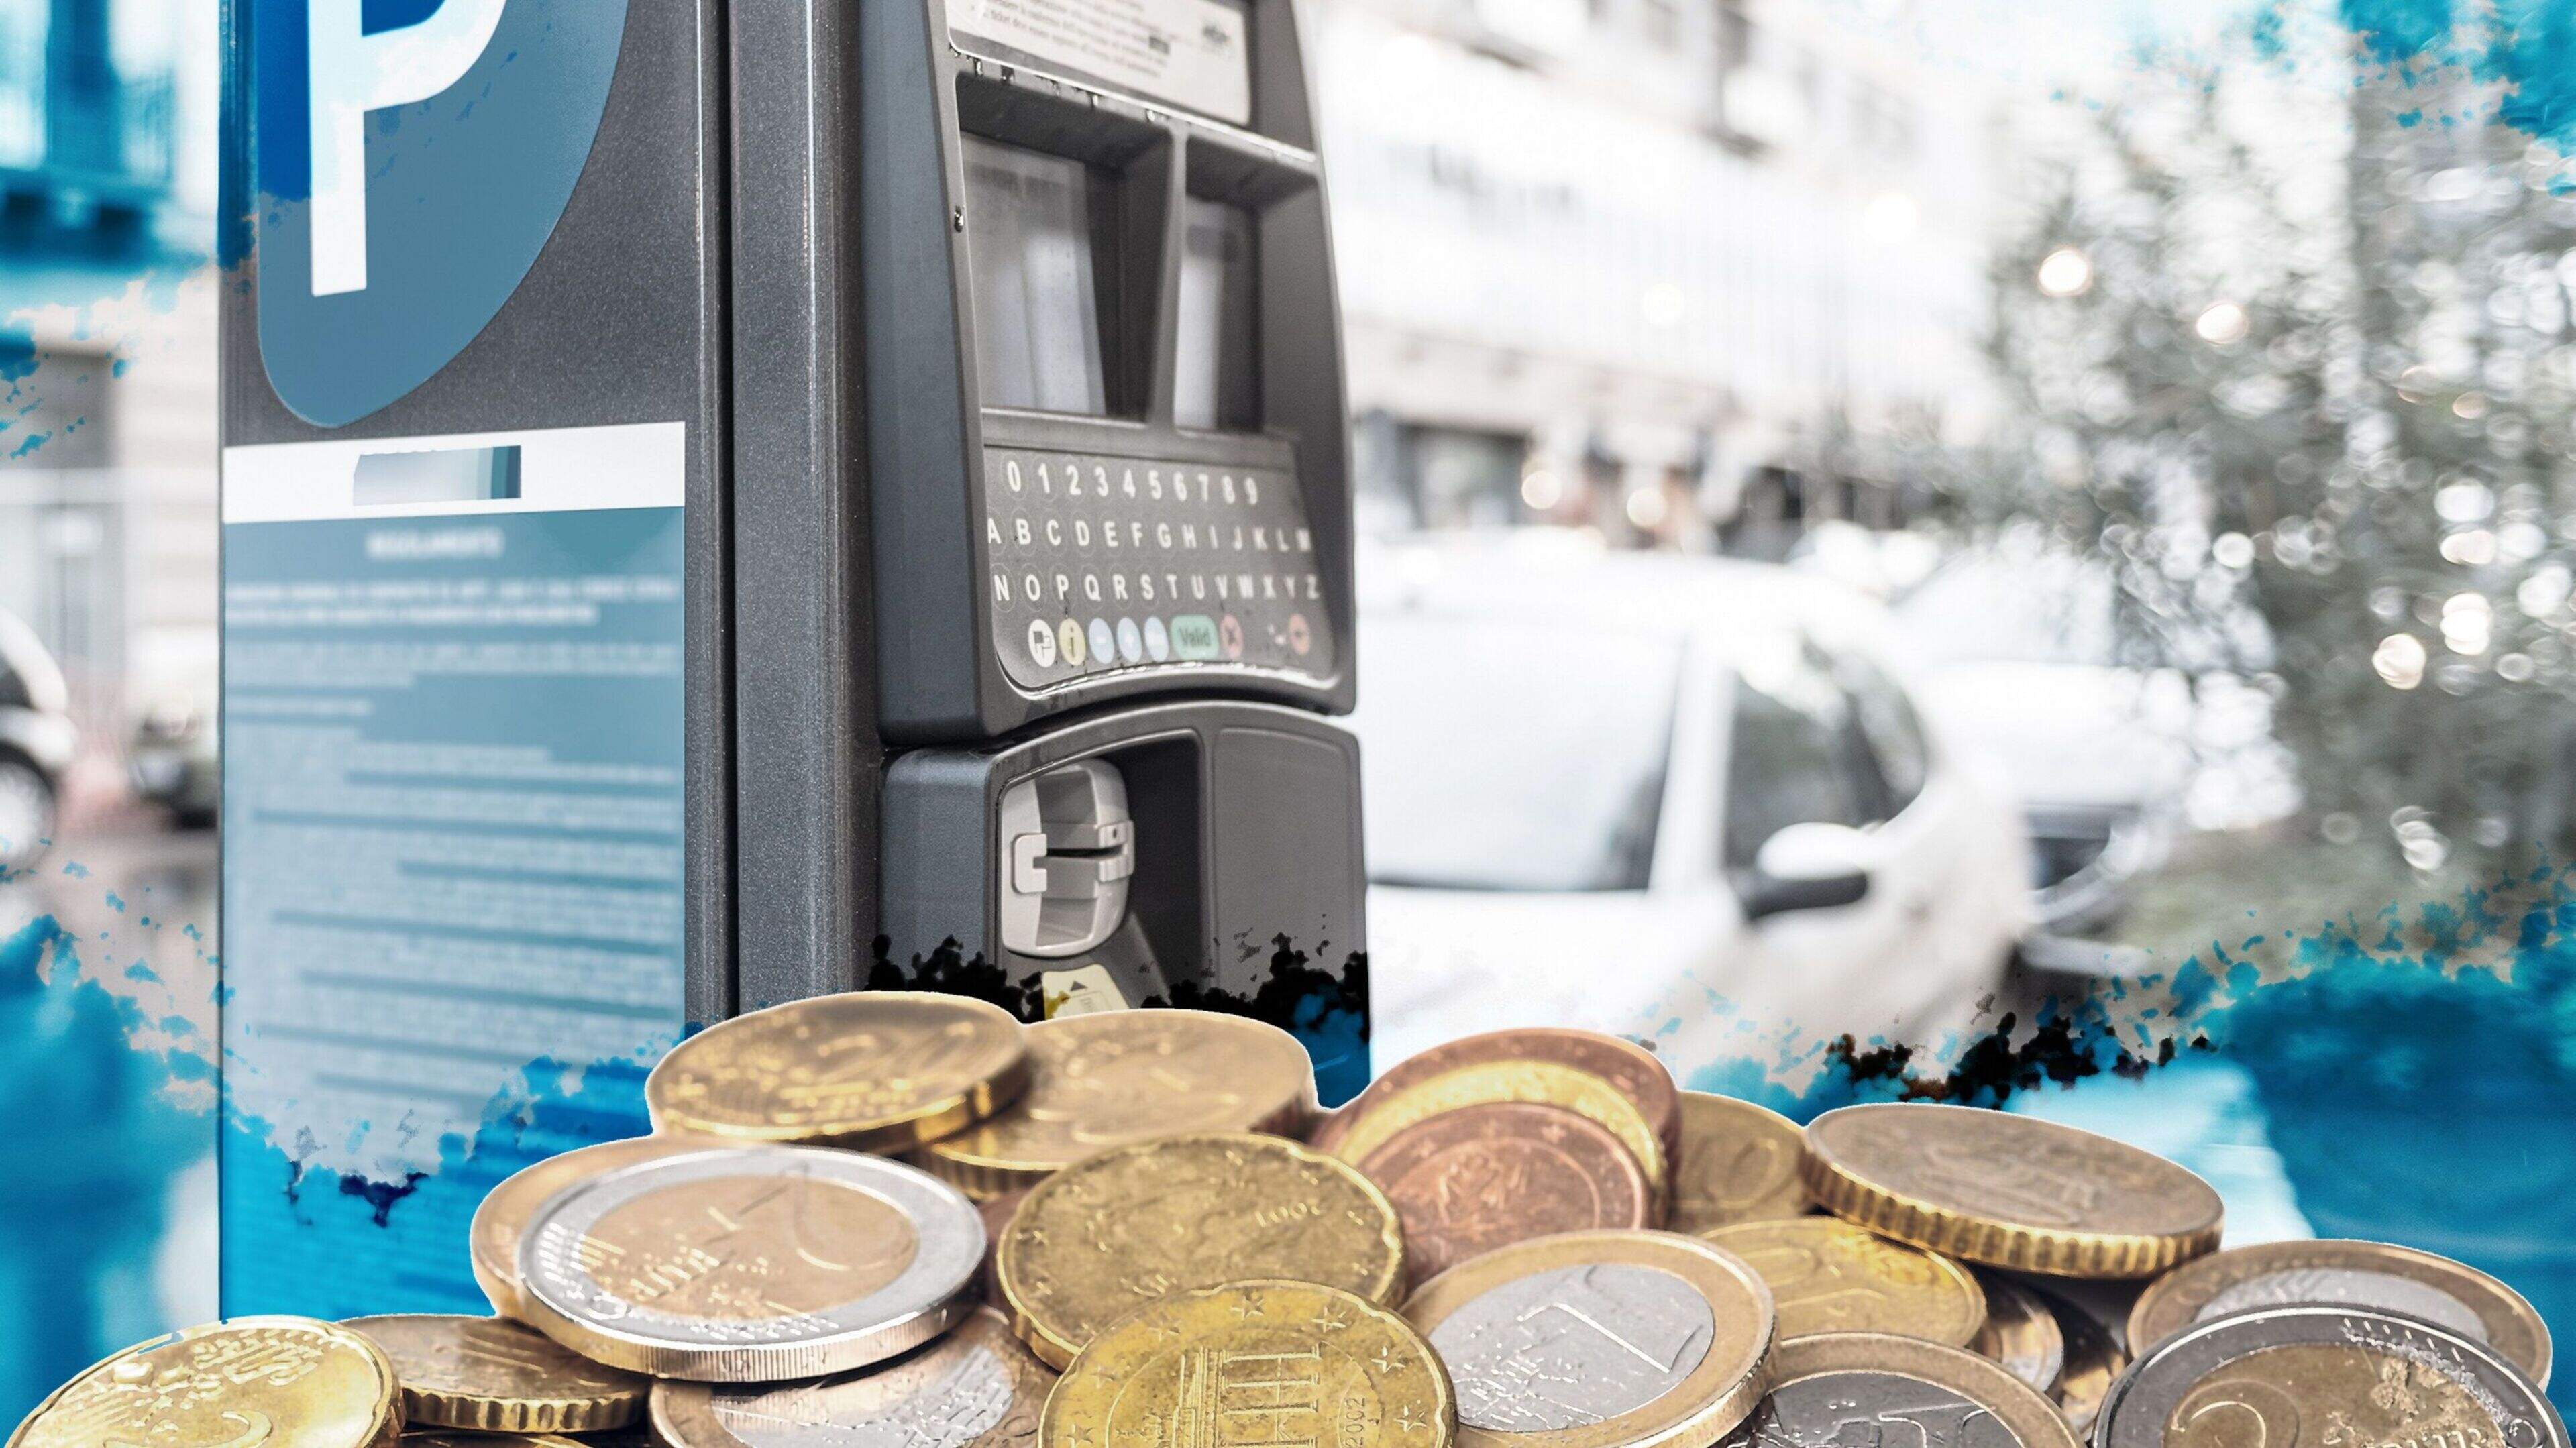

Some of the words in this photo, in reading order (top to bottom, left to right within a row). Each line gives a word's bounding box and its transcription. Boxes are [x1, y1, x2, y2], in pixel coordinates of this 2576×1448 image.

[309, 0, 507, 297] P
[1008, 461, 1021, 492] 0
[1038, 463, 1050, 493] 1
[1067, 465, 1081, 495] 2
[1095, 467, 1108, 496] 3
[1123, 469, 1135, 497] 4
[1148, 470, 1161, 499] 5
[1174, 471, 1187, 501] 6
[1198, 474, 1208, 501] 7
[1222, 475, 1235, 504] 8
[1245, 477, 1257, 504] 9
[988, 518, 1001, 543] A
[1016, 519, 1031, 545] B
[1047, 520, 1061, 545] C
[1075, 520, 1089, 546] D
[1104, 521, 1118, 547] E
[1132, 522, 1142, 547] F
[1157, 523, 1171, 548] G
[1183, 525, 1196, 547] H
[1234, 527, 1242, 550] J
[1254, 528, 1267, 549] K
[1277, 529, 1289, 551] L
[994, 575, 1010, 600] N
[1026, 574, 1040, 601] O
[1056, 575, 1069, 600] P
[1085, 575, 1101, 601] Q
[1113, 575, 1128, 599] R
[1140, 575, 1154, 600] S
[1167, 575, 1177, 598] T
[1191, 576, 1205, 599] U
[1216, 576, 1227, 598] V
[1307, 575, 1318, 599] Z
[1343, 1396, 1367, 1448] 2002
